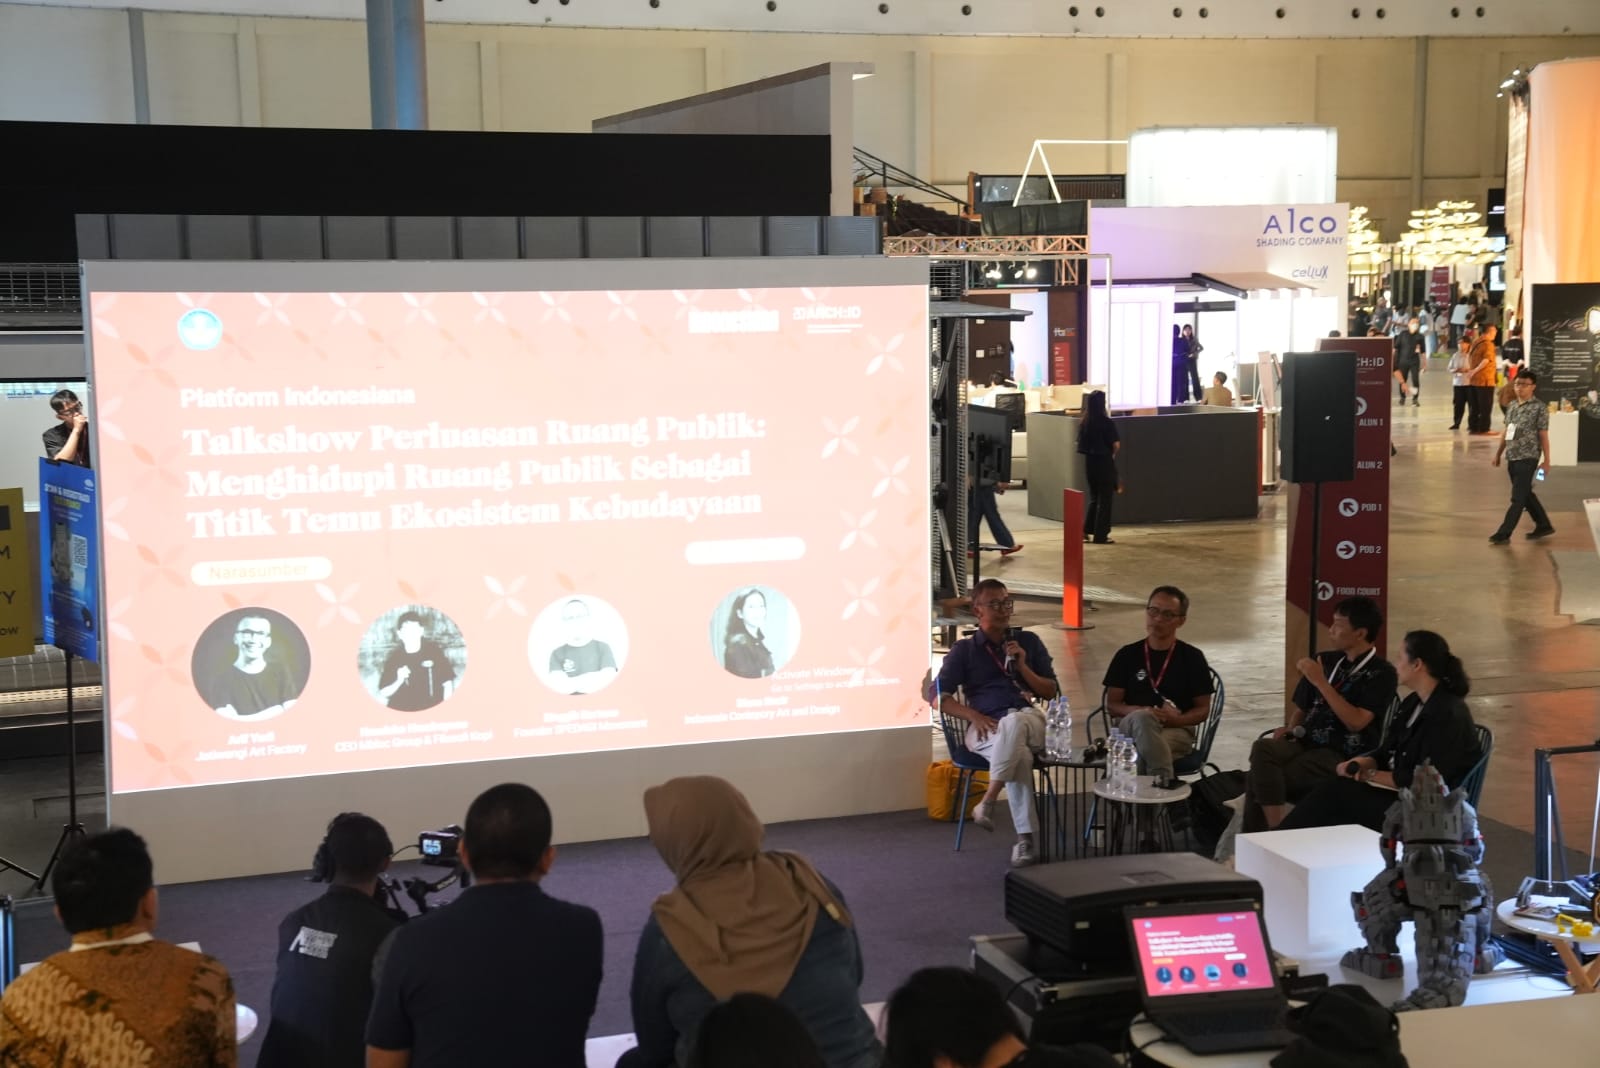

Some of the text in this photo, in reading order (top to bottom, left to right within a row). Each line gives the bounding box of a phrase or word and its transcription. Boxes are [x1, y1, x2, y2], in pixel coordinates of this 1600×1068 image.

[1256, 236, 1344, 247] SHADING COMPANY
[180, 384, 416, 408] Platform Indonesiana
[182, 412, 767, 456] Talkshow Perluasan Ruang Publik:
[1376, 461, 1383, 469] 2
[185, 449, 752, 500] Menghidupi Ruang Publik Sebagai
[1377, 503, 1382, 512] 1
[185, 492, 763, 538] Titik Temu Ekosistem Kebudayaan
[1375, 545, 1382, 554] 2
[209, 563, 309, 580] Narasumber
[1336, 587, 1380, 595] FOOD COURT
[771, 669, 810, 681] Activate
[809, 704, 841, 716] Design
[249, 746, 266, 757] Art
[266, 744, 308, 756] Factory
[335, 741, 358, 752] CEO
